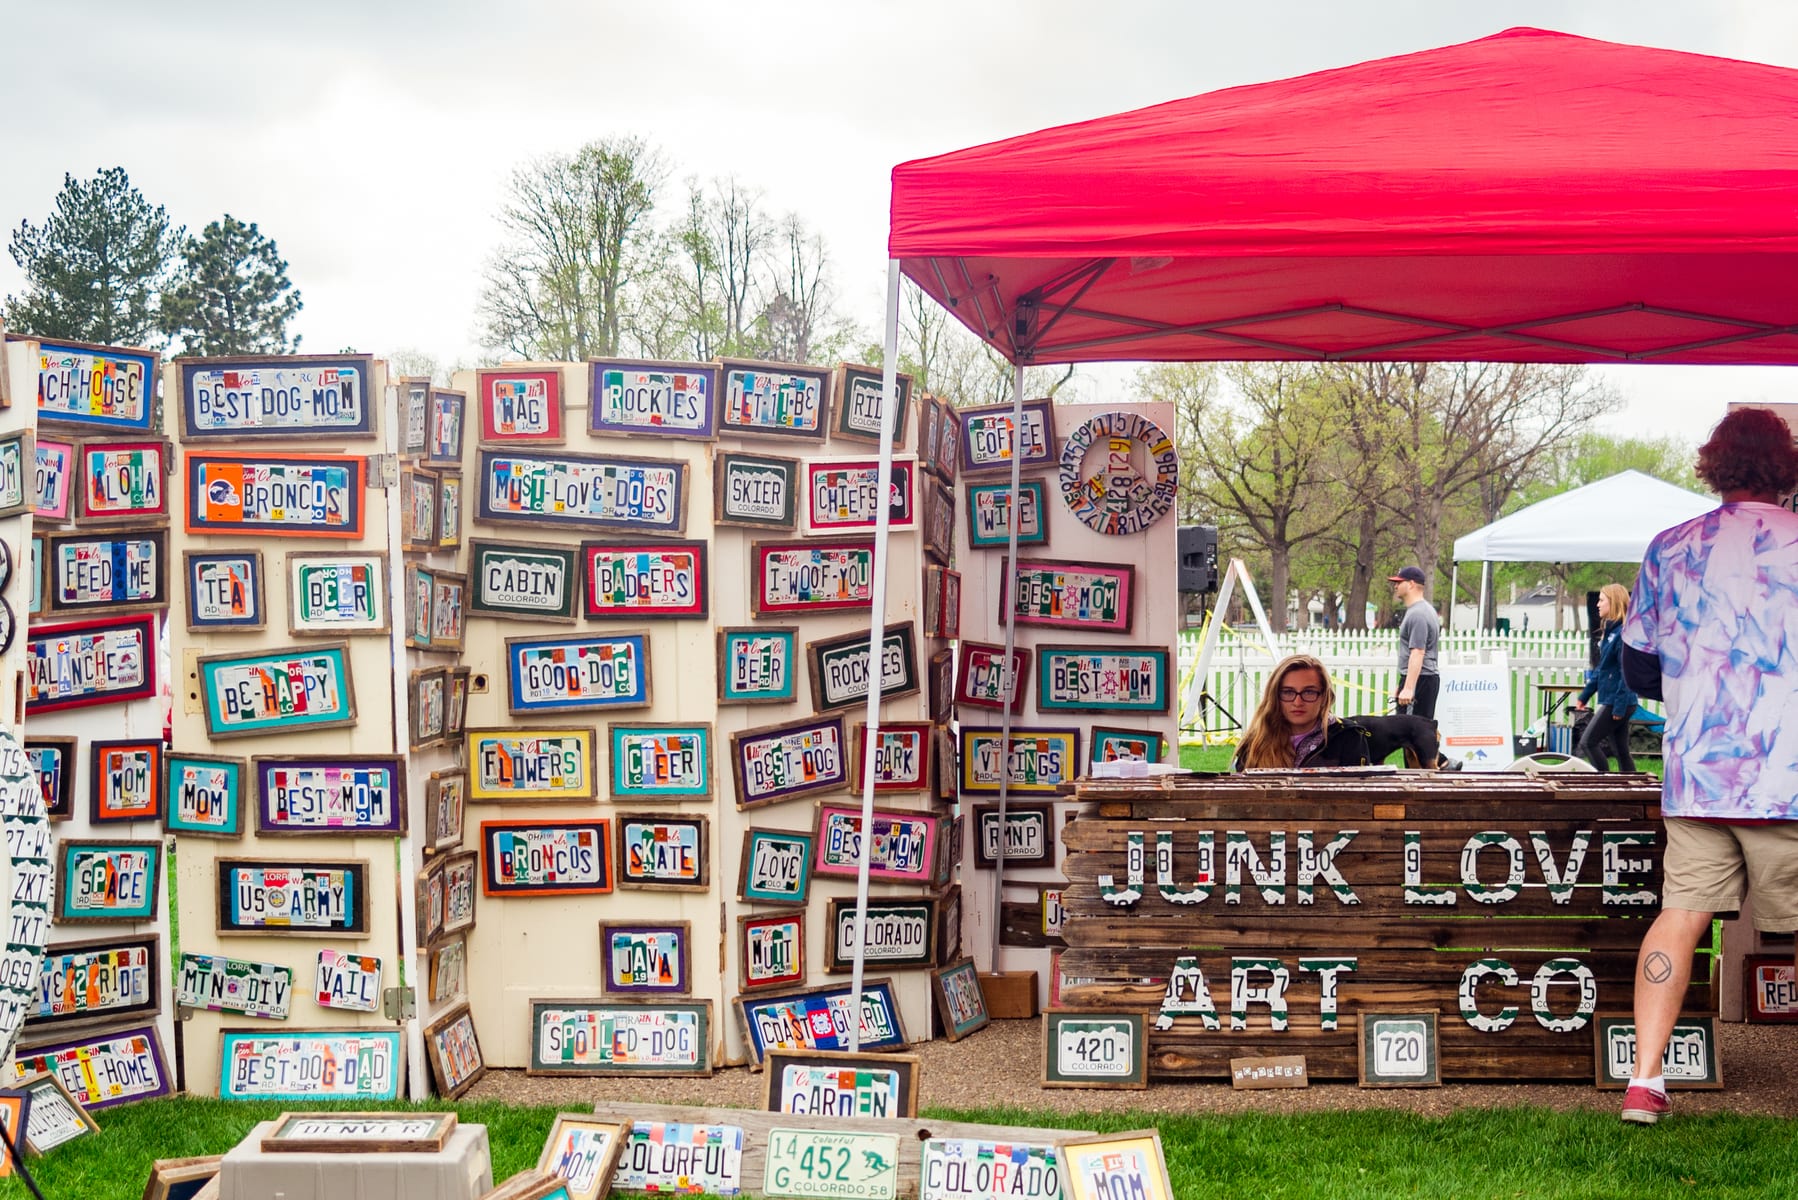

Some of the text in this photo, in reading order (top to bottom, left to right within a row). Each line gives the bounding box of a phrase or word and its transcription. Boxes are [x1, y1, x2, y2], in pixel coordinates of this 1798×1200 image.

[503, 395, 539, 424] WAG
[95, 470, 155, 502] ALOHA
[244, 483, 342, 516] BRONCOS
[733, 478, 781, 505] SKIER
[738, 503, 775, 514] COLORADO
[66, 559, 151, 592] FEED ME
[489, 568, 556, 596] CABIN
[601, 567, 689, 598] BADGERS
[205, 577, 243, 613] TEA
[312, 581, 366, 613] BEER
[497, 594, 548, 605] COLORADO
[1019, 581, 1115, 612] BEST MOM
[738, 652, 781, 684] BEER
[831, 651, 901, 689] ROCKES
[1055, 664, 1151, 696] BEST MOM
[1445, 679, 1498, 693] Activities
[485, 751, 575, 783] FLOWERS
[629, 749, 693, 778] CHEER
[112, 768, 146, 800] MOM
[184, 784, 223, 816] MOM
[277, 785, 383, 817] BEST MOM
[502, 841, 592, 876] BRONCOS
[632, 838, 693, 870] SKATE
[888, 834, 919, 865] MOM
[758, 852, 798, 880] LOVE
[1098, 830, 1659, 905] JUNK LOVE
[81, 864, 144, 900] SPACE
[241, 886, 345, 916] US ARMY
[844, 923, 922, 948] CLORADO
[621, 948, 672, 977] JAVA
[752, 939, 792, 970] MUTT
[185, 967, 287, 1007] MTN DIV
[322, 965, 371, 1008] VAIL
[1154, 956, 1597, 1033] ART CO
[762, 1017, 810, 1043] COAST
[1380, 1036, 1419, 1062] 720
[238, 1056, 289, 1086] BEST
[1072, 1062, 1124, 1071] COLORADO
[812, 1135, 856, 1145] Colorful
[775, 1136, 850, 1182] 14 452
[794, 1181, 888, 1196] COLORADO 58
[928, 1158, 1059, 1199] COLORADO
